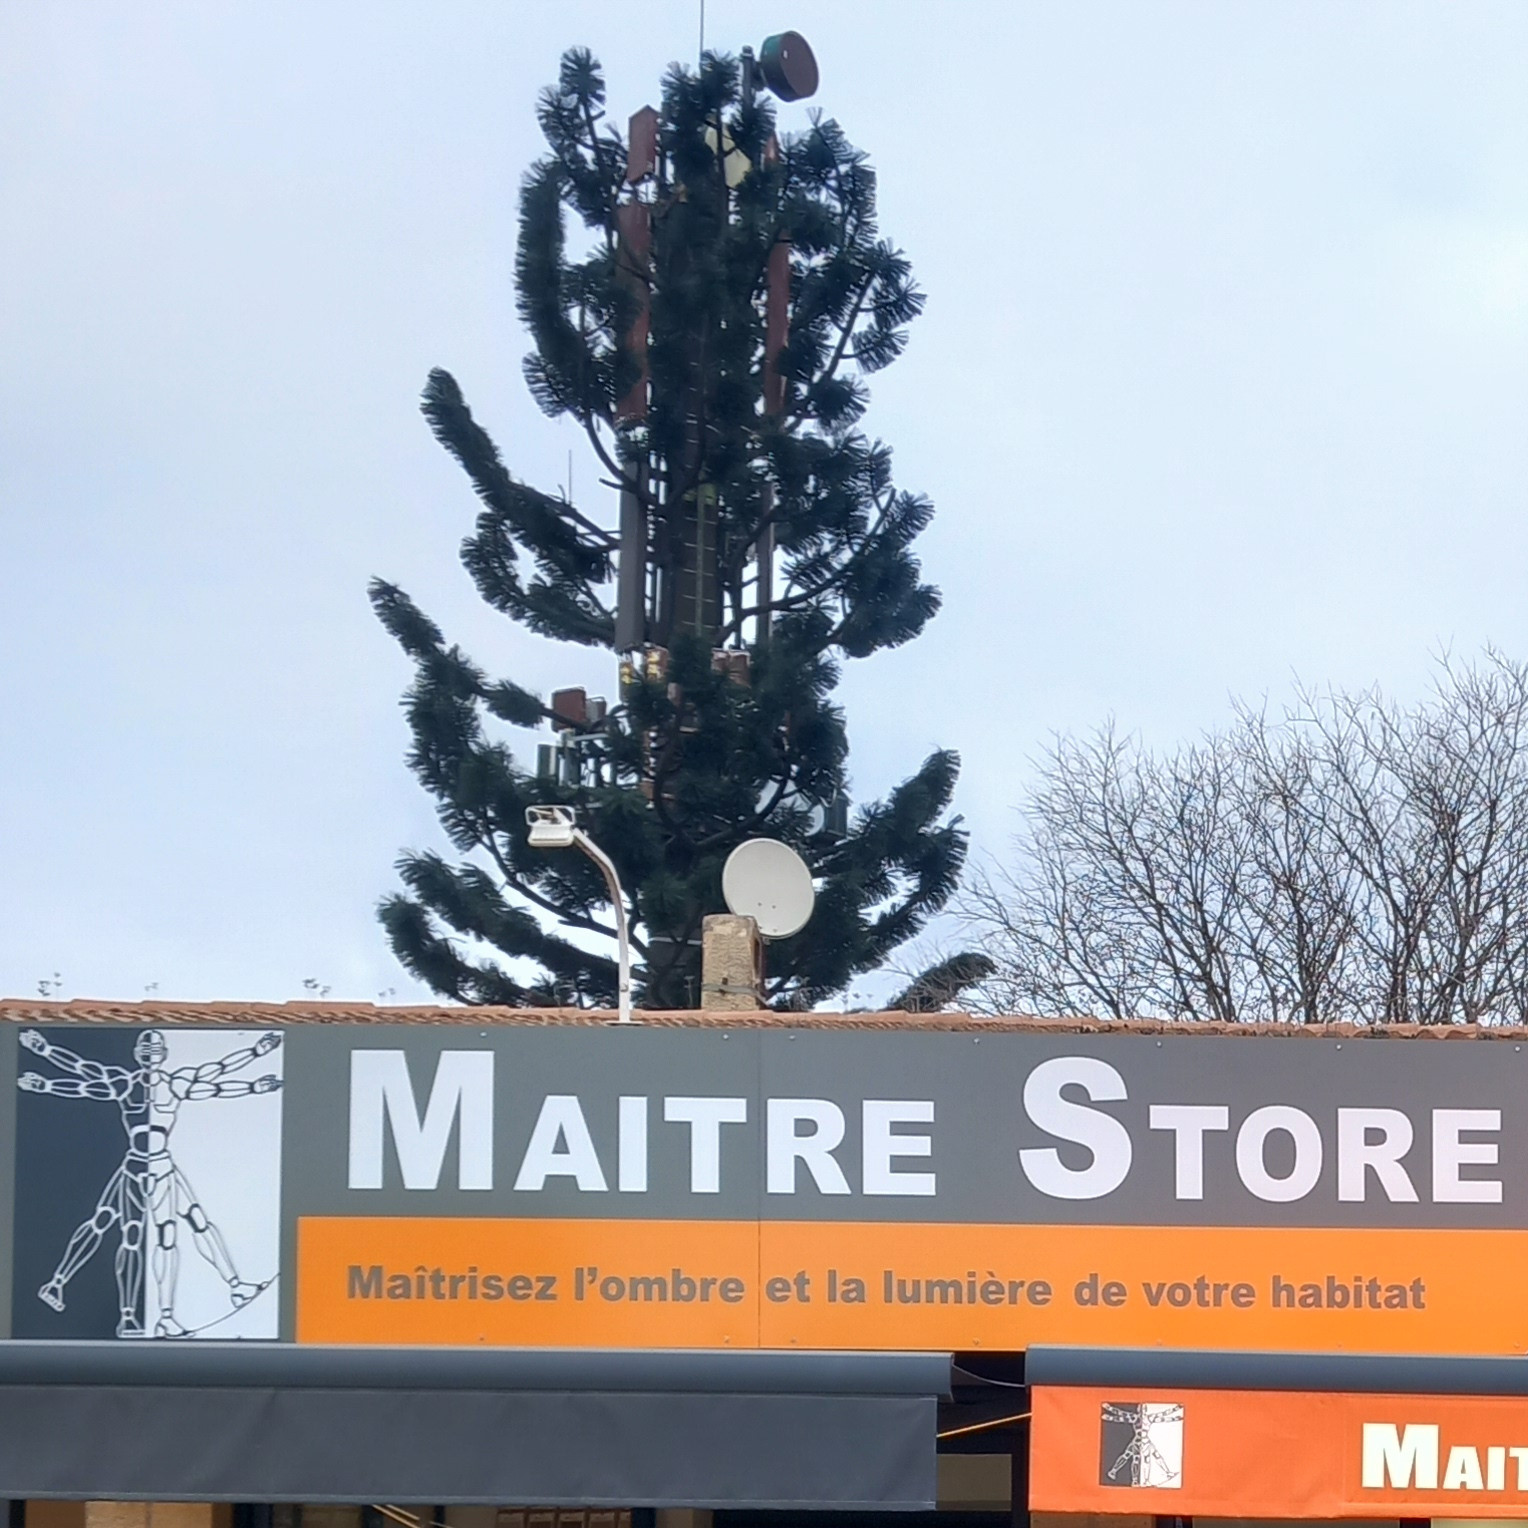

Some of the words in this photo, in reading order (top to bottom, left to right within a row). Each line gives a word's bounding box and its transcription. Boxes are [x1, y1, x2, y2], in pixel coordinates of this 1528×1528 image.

[348, 1049, 935, 1196] MAITRE
[1019, 1056, 1502, 1203] STORE
[347, 1264, 557, 1302] Maîtrisez
[766, 1269, 810, 1304] et
[826, 1269, 865, 1304] la
[883, 1270, 1052, 1306] lumière
[1074, 1272, 1127, 1307] de
[1142, 1276, 1256, 1308] votre
[1271, 1275, 1426, 1309] habitat
